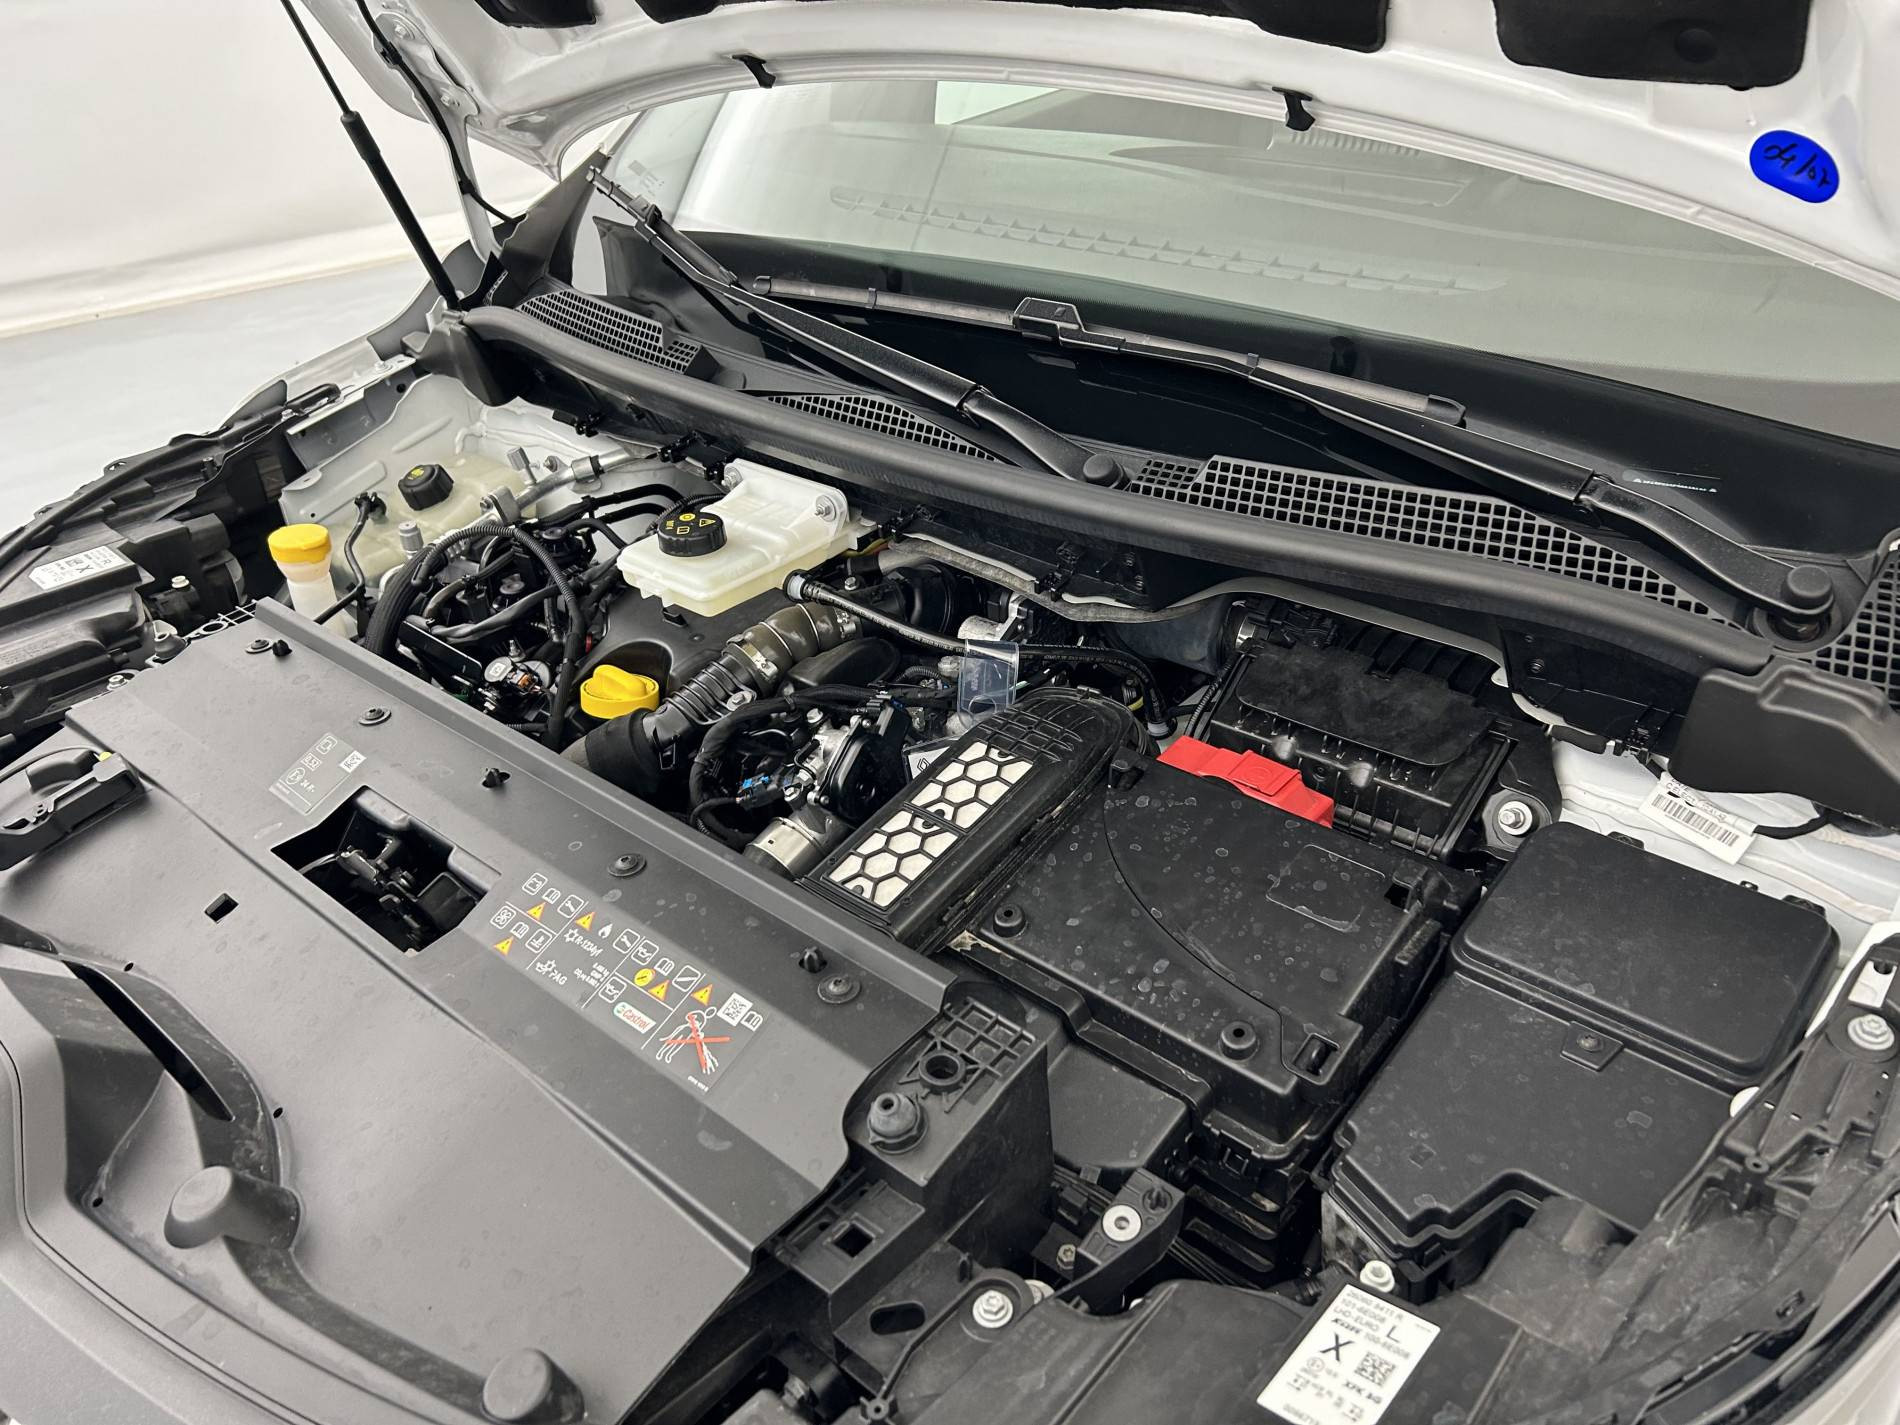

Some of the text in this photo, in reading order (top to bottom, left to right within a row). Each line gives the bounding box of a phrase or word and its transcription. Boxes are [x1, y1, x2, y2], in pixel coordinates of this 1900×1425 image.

[622, 1008, 650, 1031] Castrol
[1386, 1325, 1400, 1343] L
[1319, 1332, 1355, 1362] X
